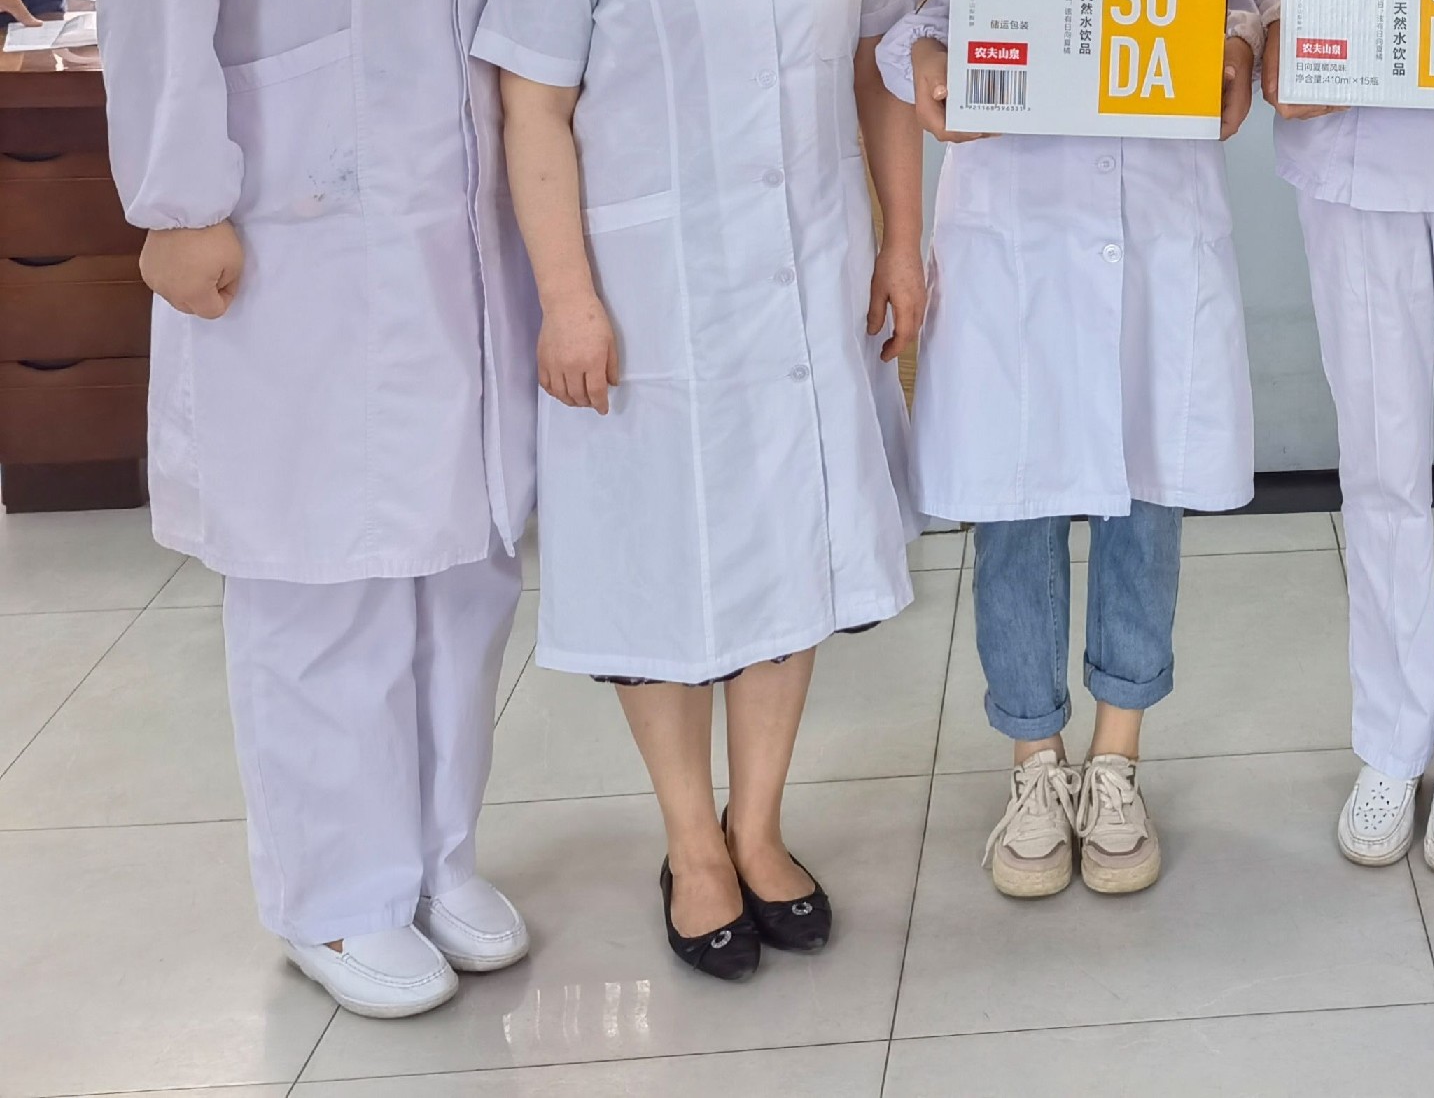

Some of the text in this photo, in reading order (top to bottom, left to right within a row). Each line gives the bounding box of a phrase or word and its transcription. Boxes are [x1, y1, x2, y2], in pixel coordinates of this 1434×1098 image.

[990, 19, 1029, 31] 储运包装
[974, 46, 1020, 60] 农夫山泉
[1302, 43, 1341, 55] 农夫山泉
[1108, 35, 1175, 99] DA
